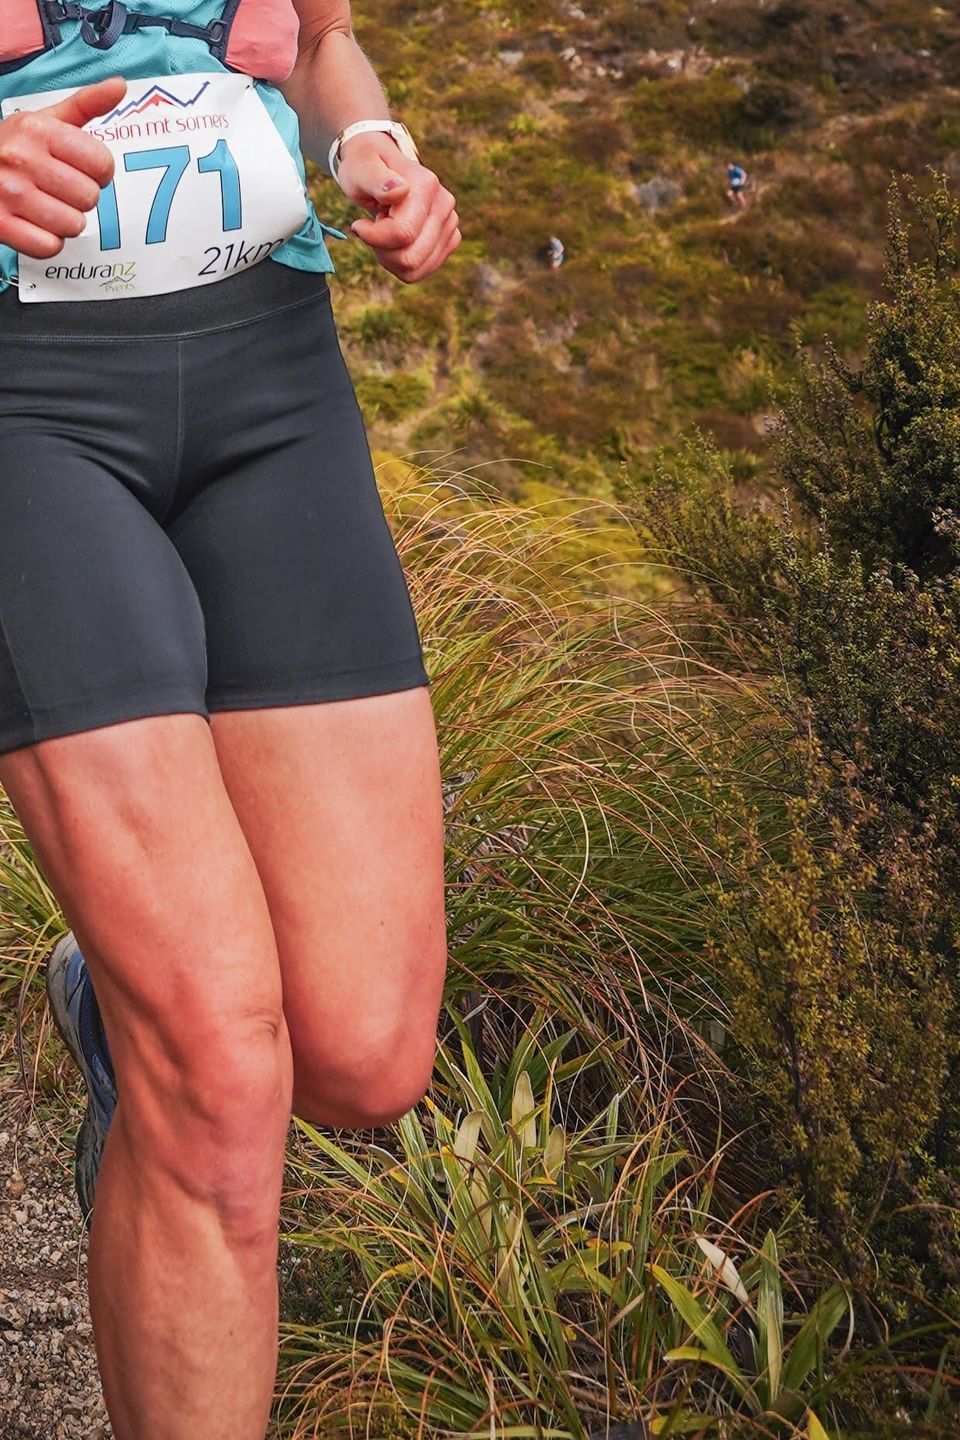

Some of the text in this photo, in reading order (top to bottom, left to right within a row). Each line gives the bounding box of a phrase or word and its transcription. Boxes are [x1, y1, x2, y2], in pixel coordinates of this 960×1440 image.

[89, 114, 229, 141] ission mt somers
[45, 262, 136, 280] enduranz
